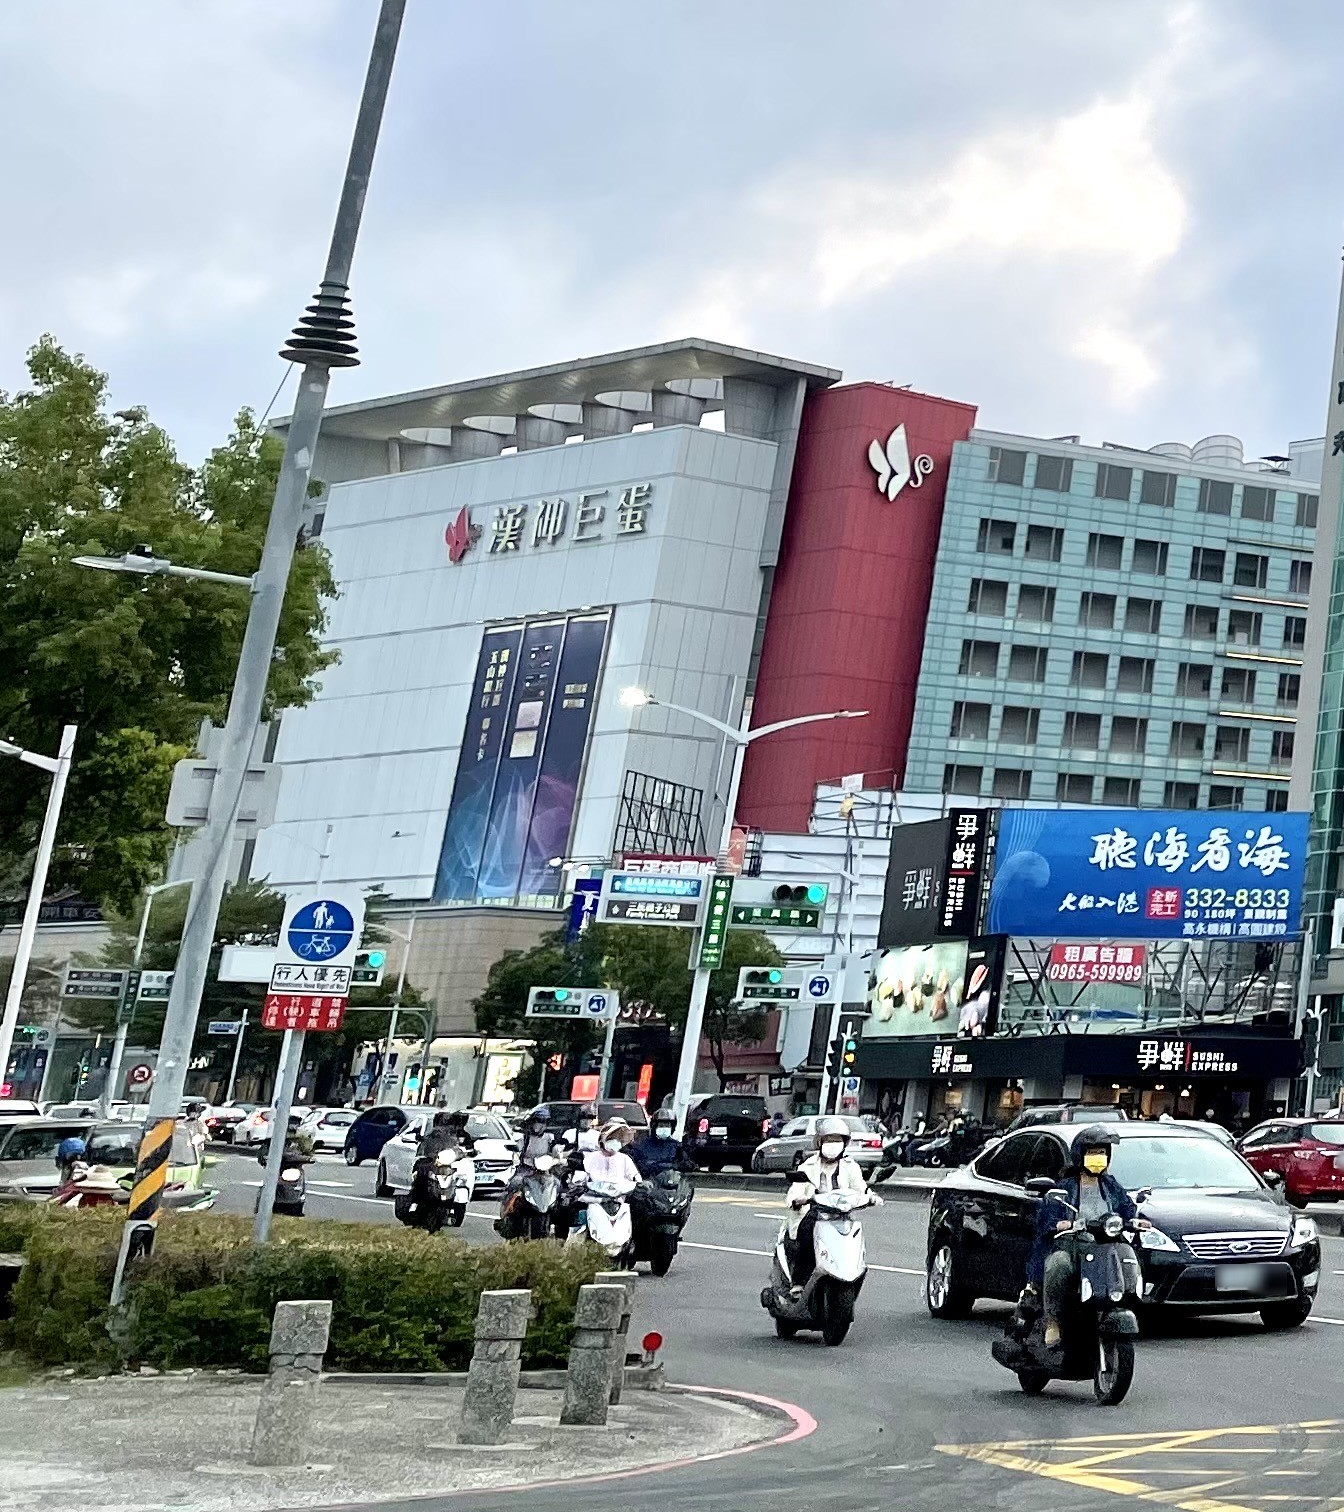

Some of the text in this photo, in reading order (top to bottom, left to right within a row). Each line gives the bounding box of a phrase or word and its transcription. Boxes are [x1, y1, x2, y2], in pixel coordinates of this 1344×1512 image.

[487, 482, 652, 554] 漢神巨蛋
[1088, 826, 1291, 876] 聽海看海
[1151, 890, 1178, 903] 全新
[1184, 889, 1291, 908] 332-8333
[1150, 904, 1177, 916] 完工
[276, 967, 347, 982] 行人優先
[1050, 964, 1142, 981] 0965-599989
[1192, 1052, 1225, 1062] SUSHI
[1191, 1062, 1238, 1072] EXPRESS
